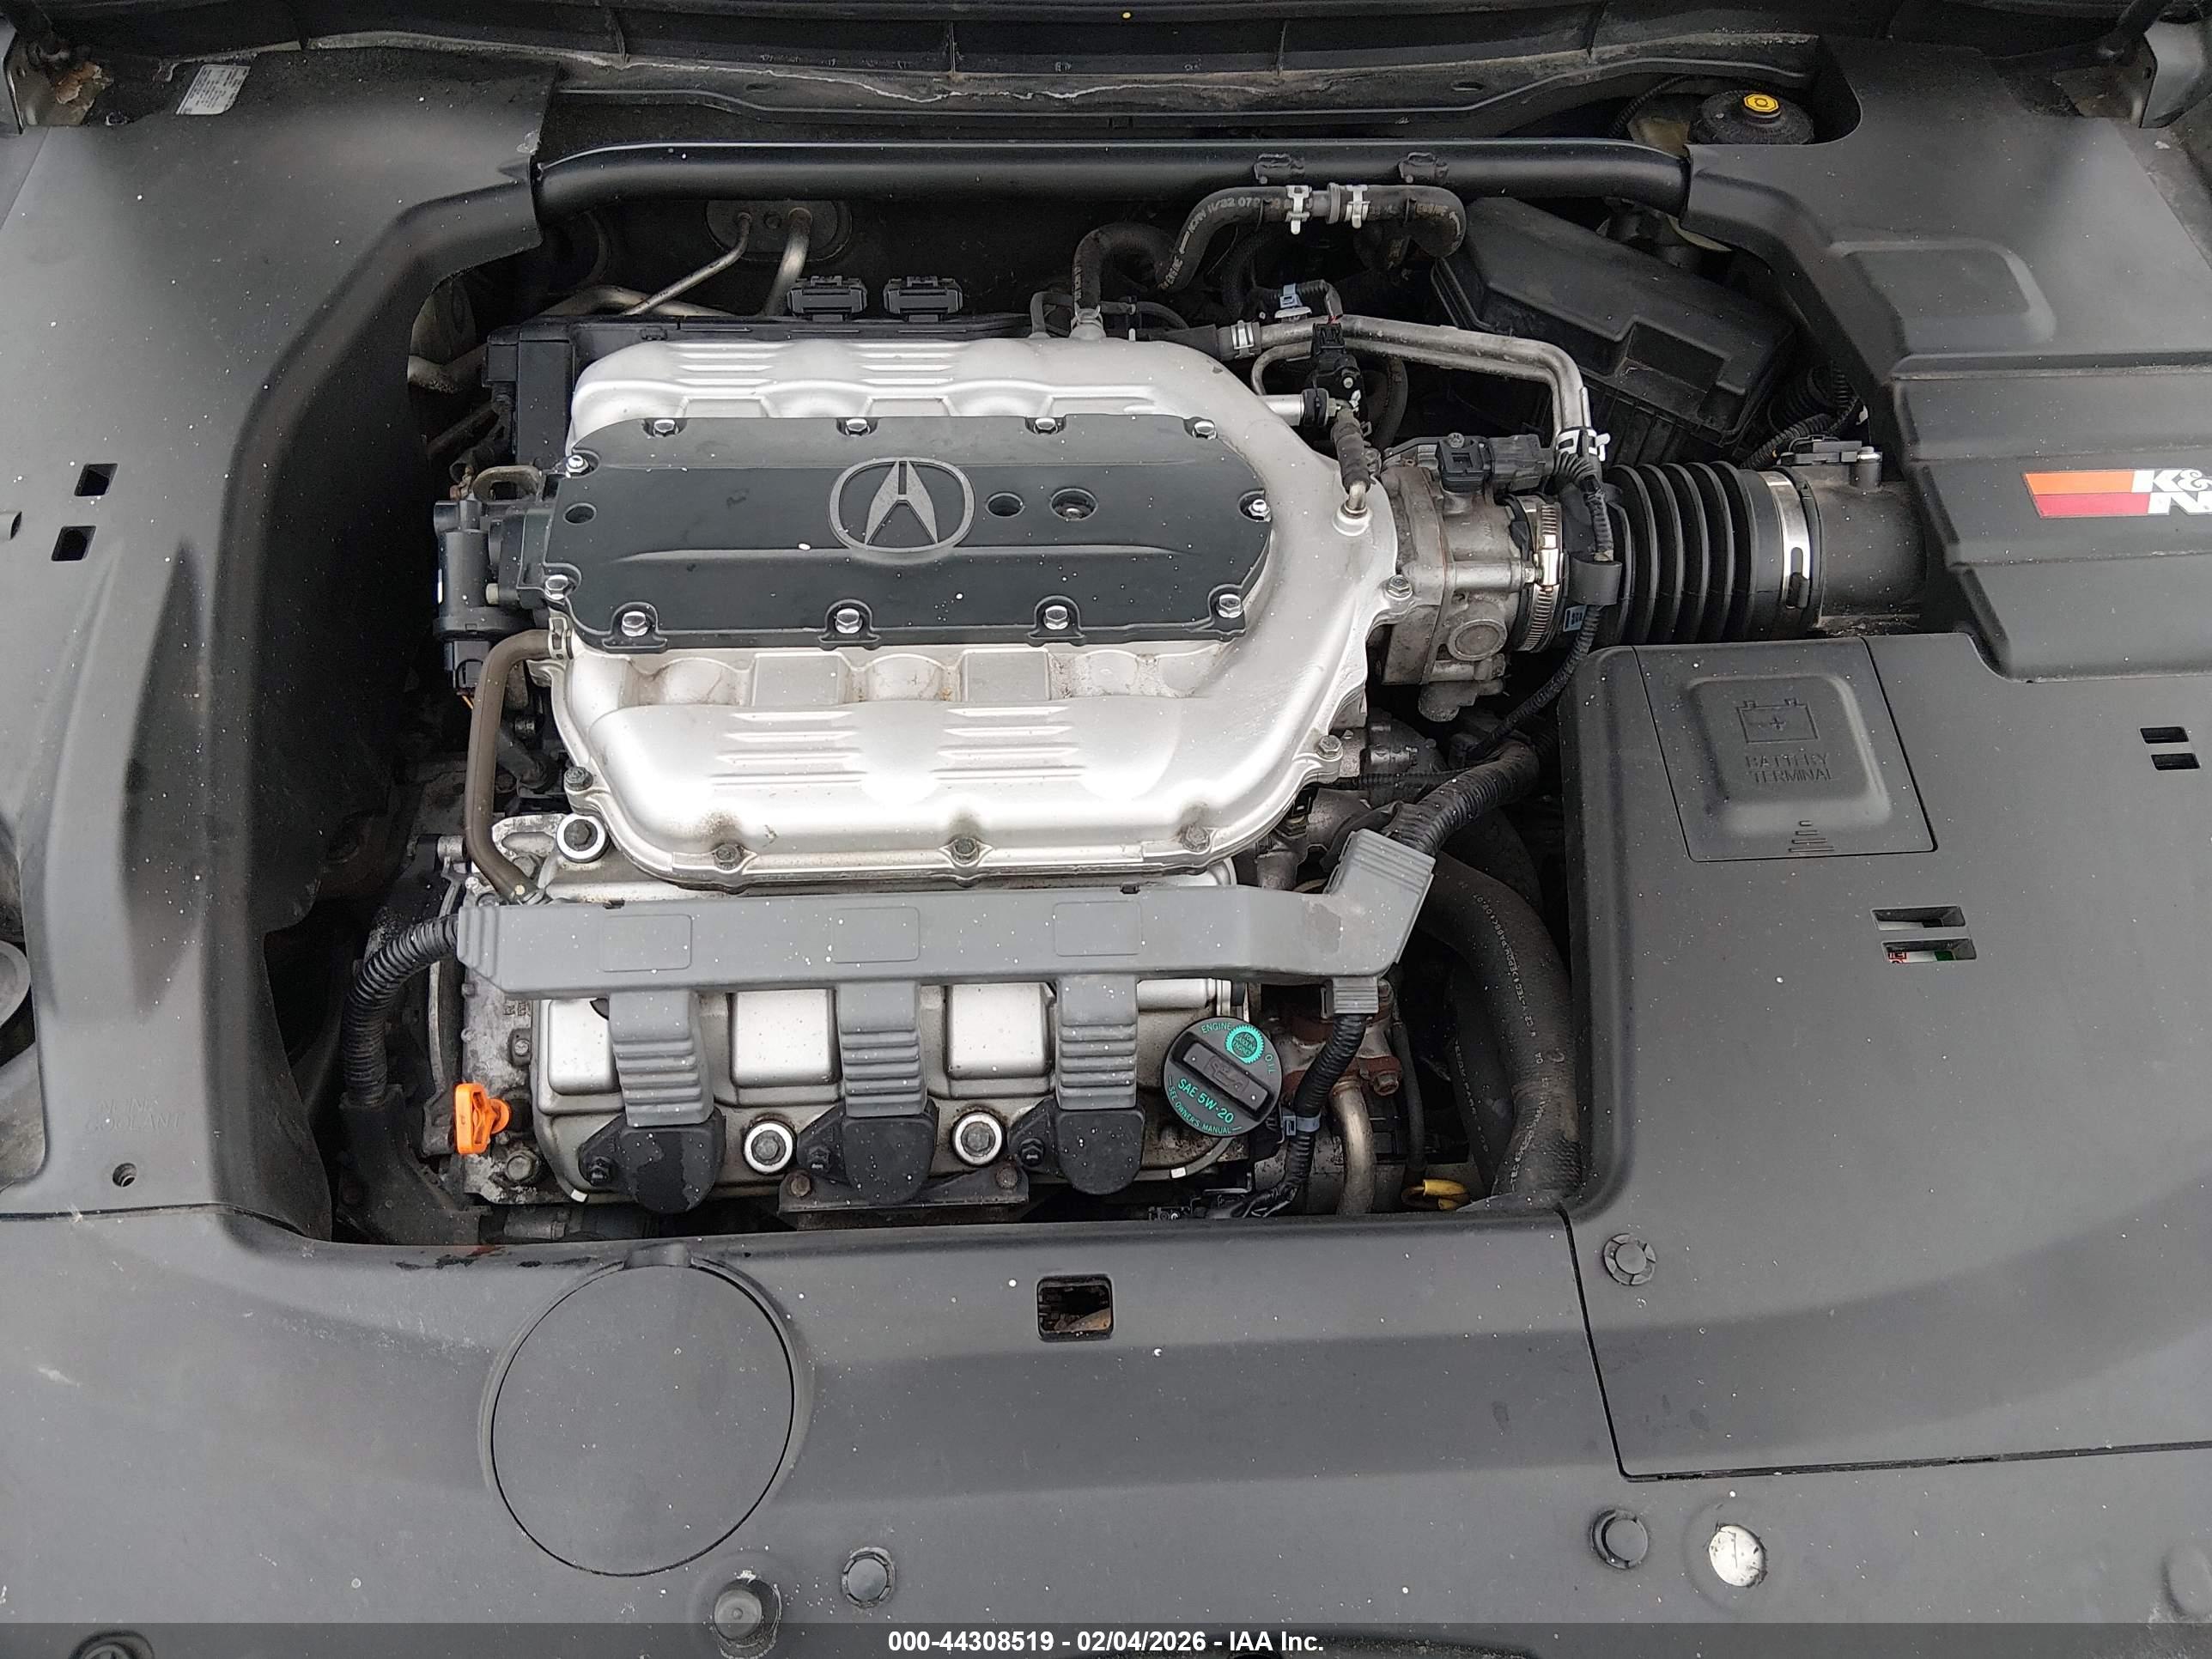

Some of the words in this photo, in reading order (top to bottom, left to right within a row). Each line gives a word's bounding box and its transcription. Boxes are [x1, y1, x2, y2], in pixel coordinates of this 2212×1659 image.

[1746, 752, 1830, 769] BATTERY
[1753, 768, 1838, 783] TERMINAL
[1201, 1022, 1232, 1034] ENGINE
[1264, 1054, 1278, 1075] OIL
[1168, 1085, 1176, 1103] SEE
[1175, 1102, 1200, 1128] OWNER'S
[1202, 1123, 1232, 1135] MANUAL
[1177, 1079, 1197, 1098] SAE
[1197, 1093, 1235, 1124] 5W-20
